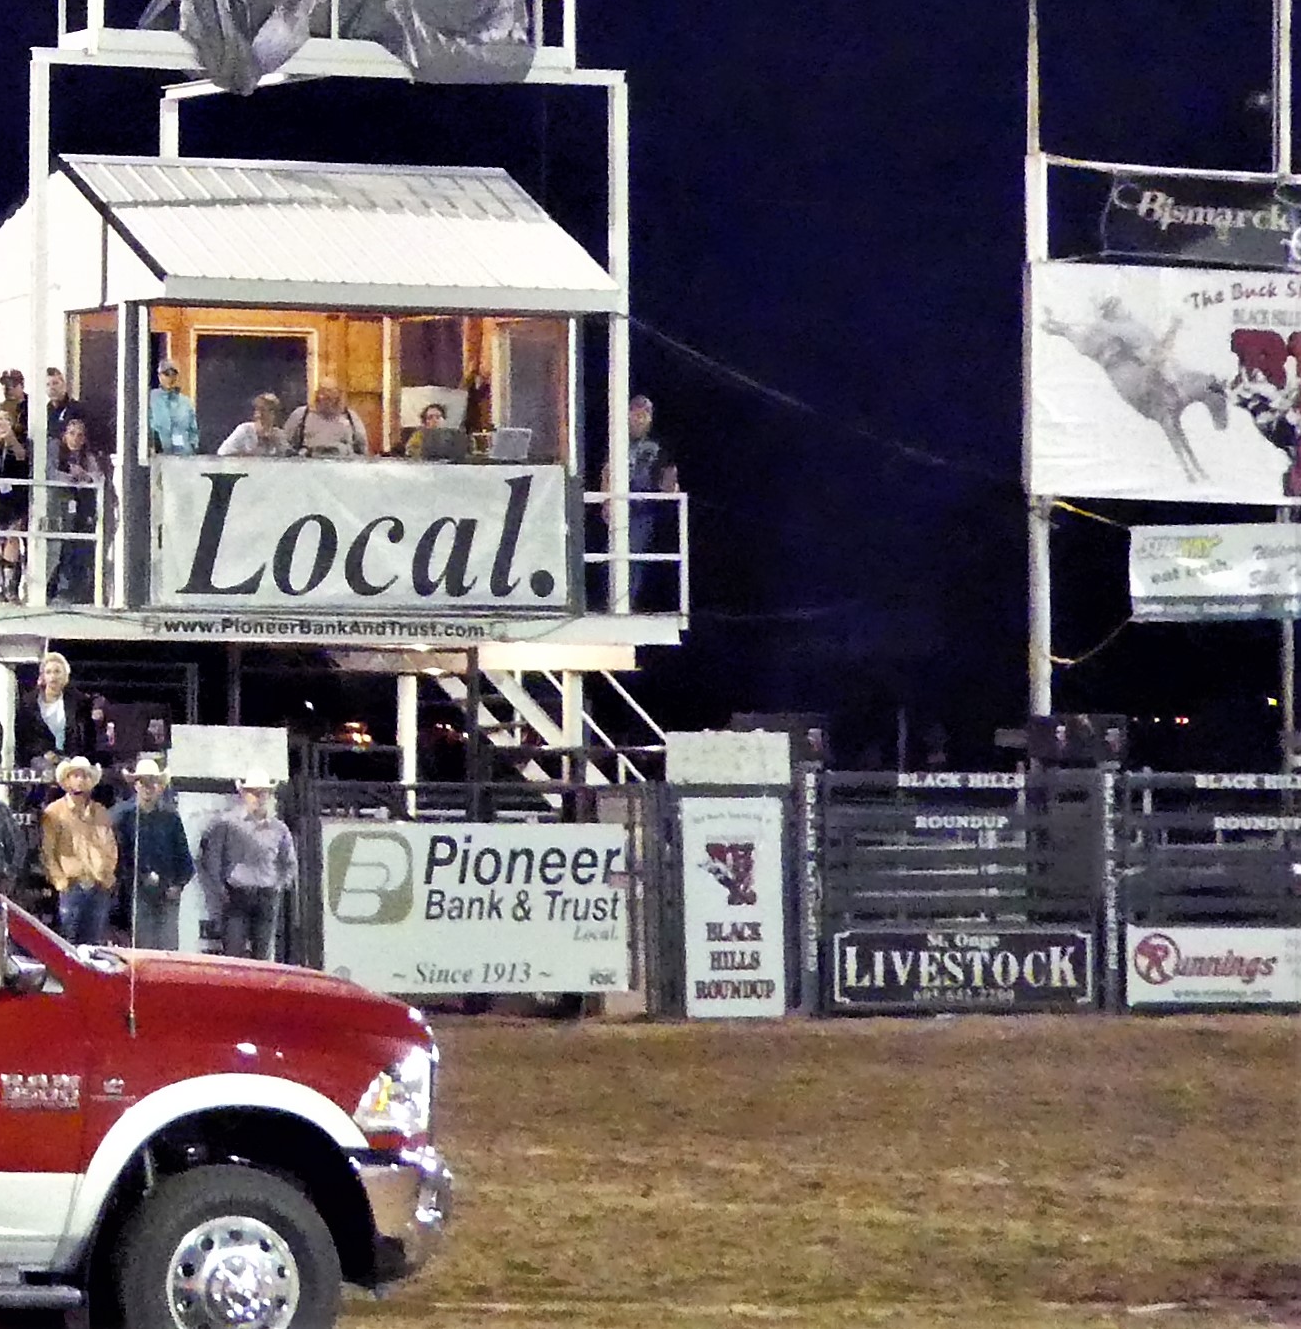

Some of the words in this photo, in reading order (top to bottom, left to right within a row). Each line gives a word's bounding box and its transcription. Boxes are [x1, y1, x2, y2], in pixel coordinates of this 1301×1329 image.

[174, 472, 557, 599] Local.
[163, 617, 487, 639] www.PioneerBankAndTrust.com
[897, 772, 962, 789] BLACK
[422, 834, 623, 886] Pioneer
[424, 890, 502, 921] Bank
[511, 891, 533, 922] &
[544, 890, 620, 922] Trust
[705, 921, 763, 943] BLACK
[709, 950, 761, 971] HILLS
[844, 945, 1079, 988] LIVESTOCK
[414, 961, 473, 985] Since
[480, 961, 532, 984] 1913
[693, 978, 777, 1000] ROUNDUP
